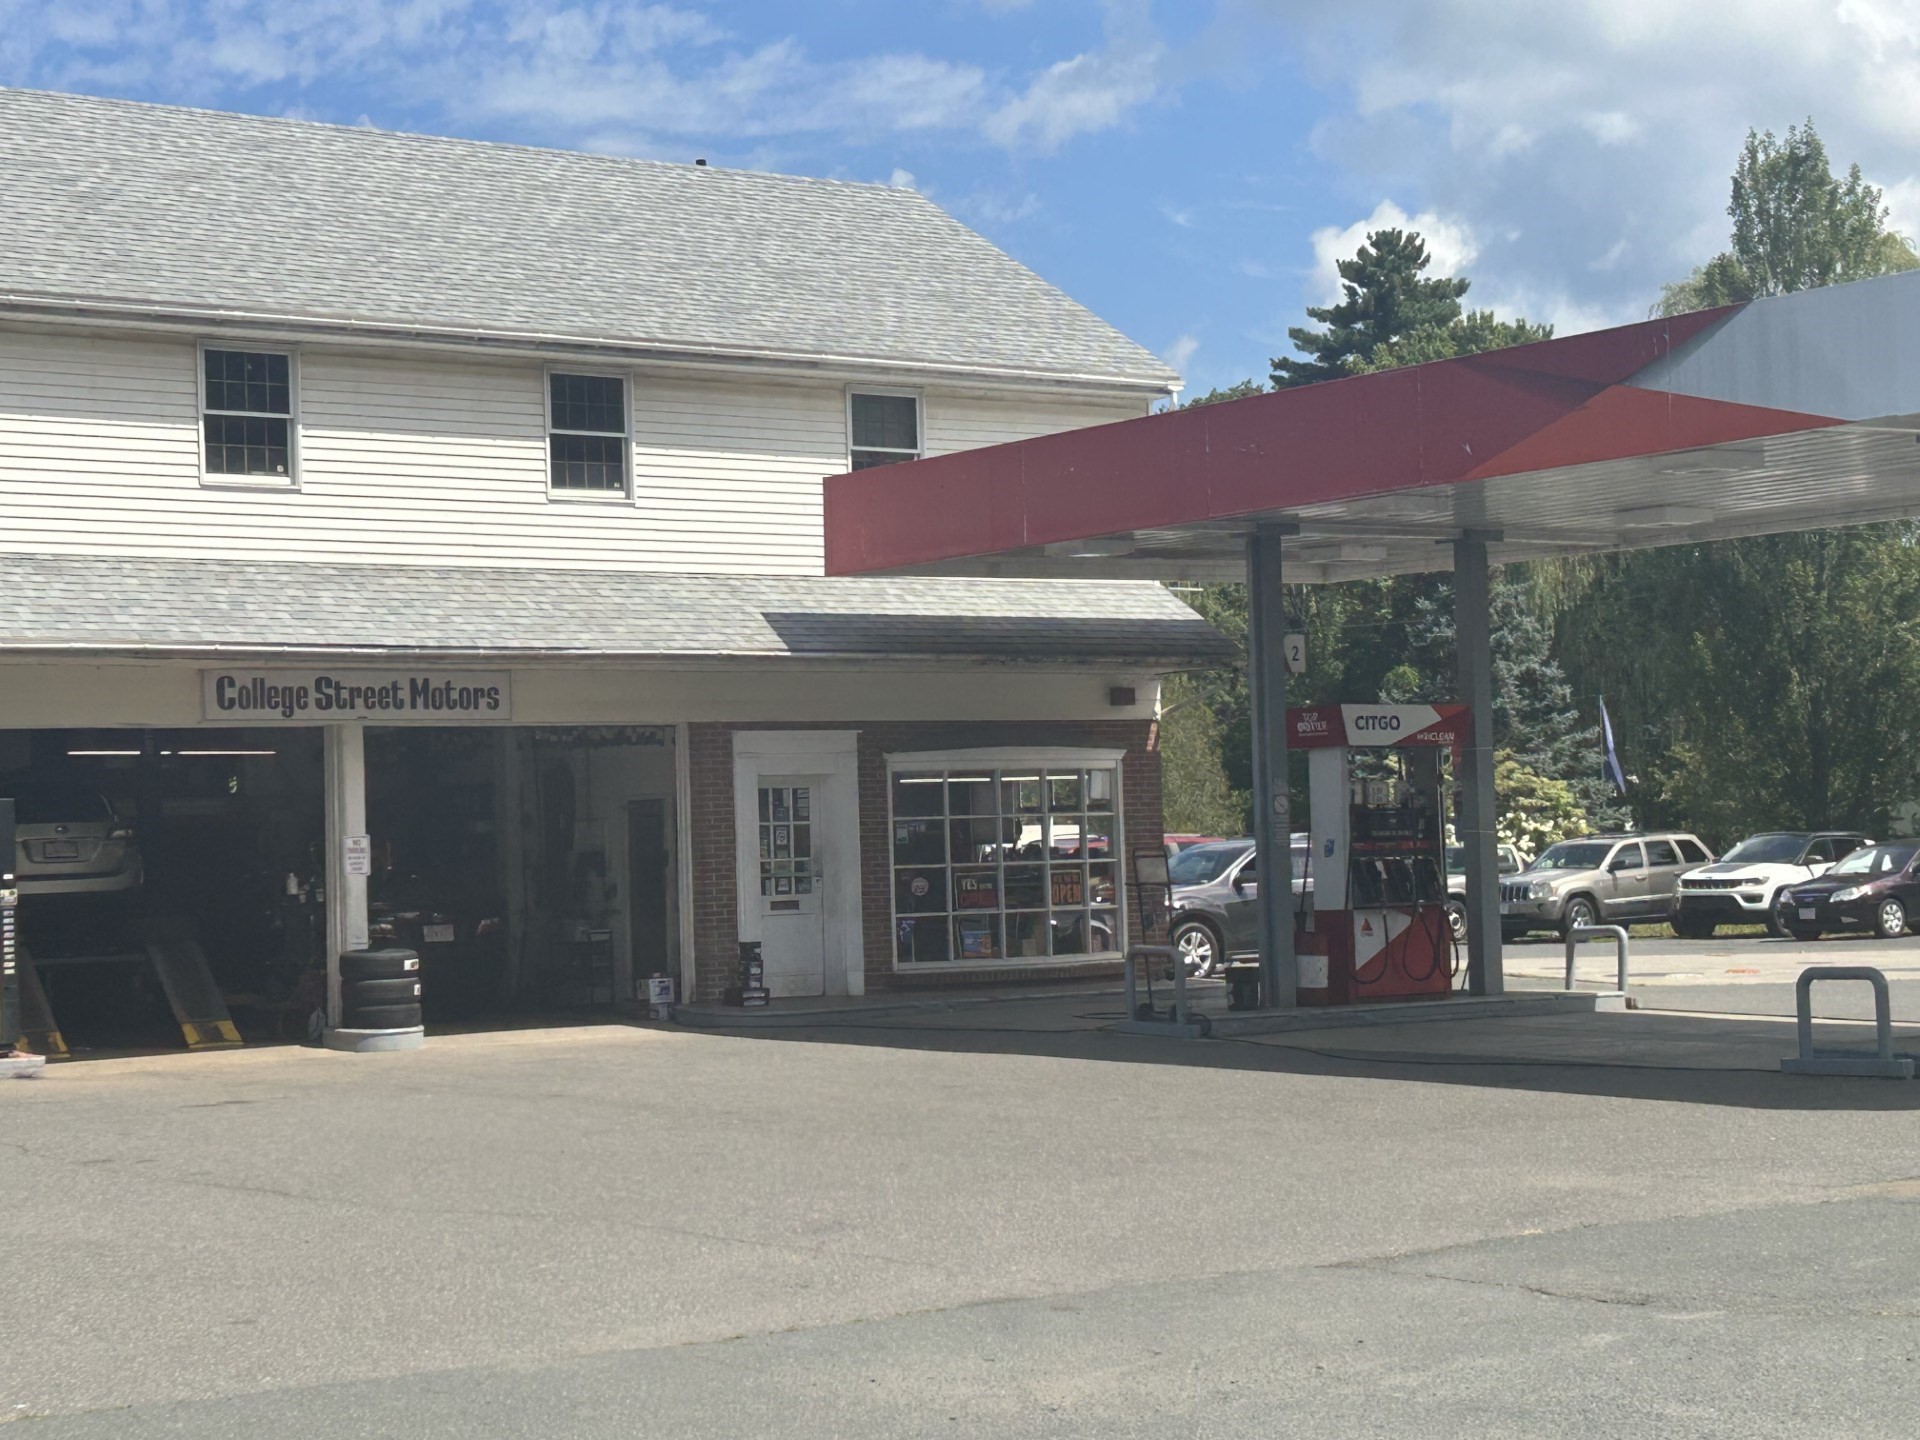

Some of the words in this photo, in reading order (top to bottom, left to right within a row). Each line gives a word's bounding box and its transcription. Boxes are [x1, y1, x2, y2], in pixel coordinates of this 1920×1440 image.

[1292, 645, 1300, 661] 2
[215, 675, 309, 718] College
[314, 676, 405, 710] Street
[409, 677, 500, 711] Motors
[1354, 715, 1401, 731] CITGO
[961, 878, 977, 890] YES
[1053, 884, 1081, 904] OPEN
